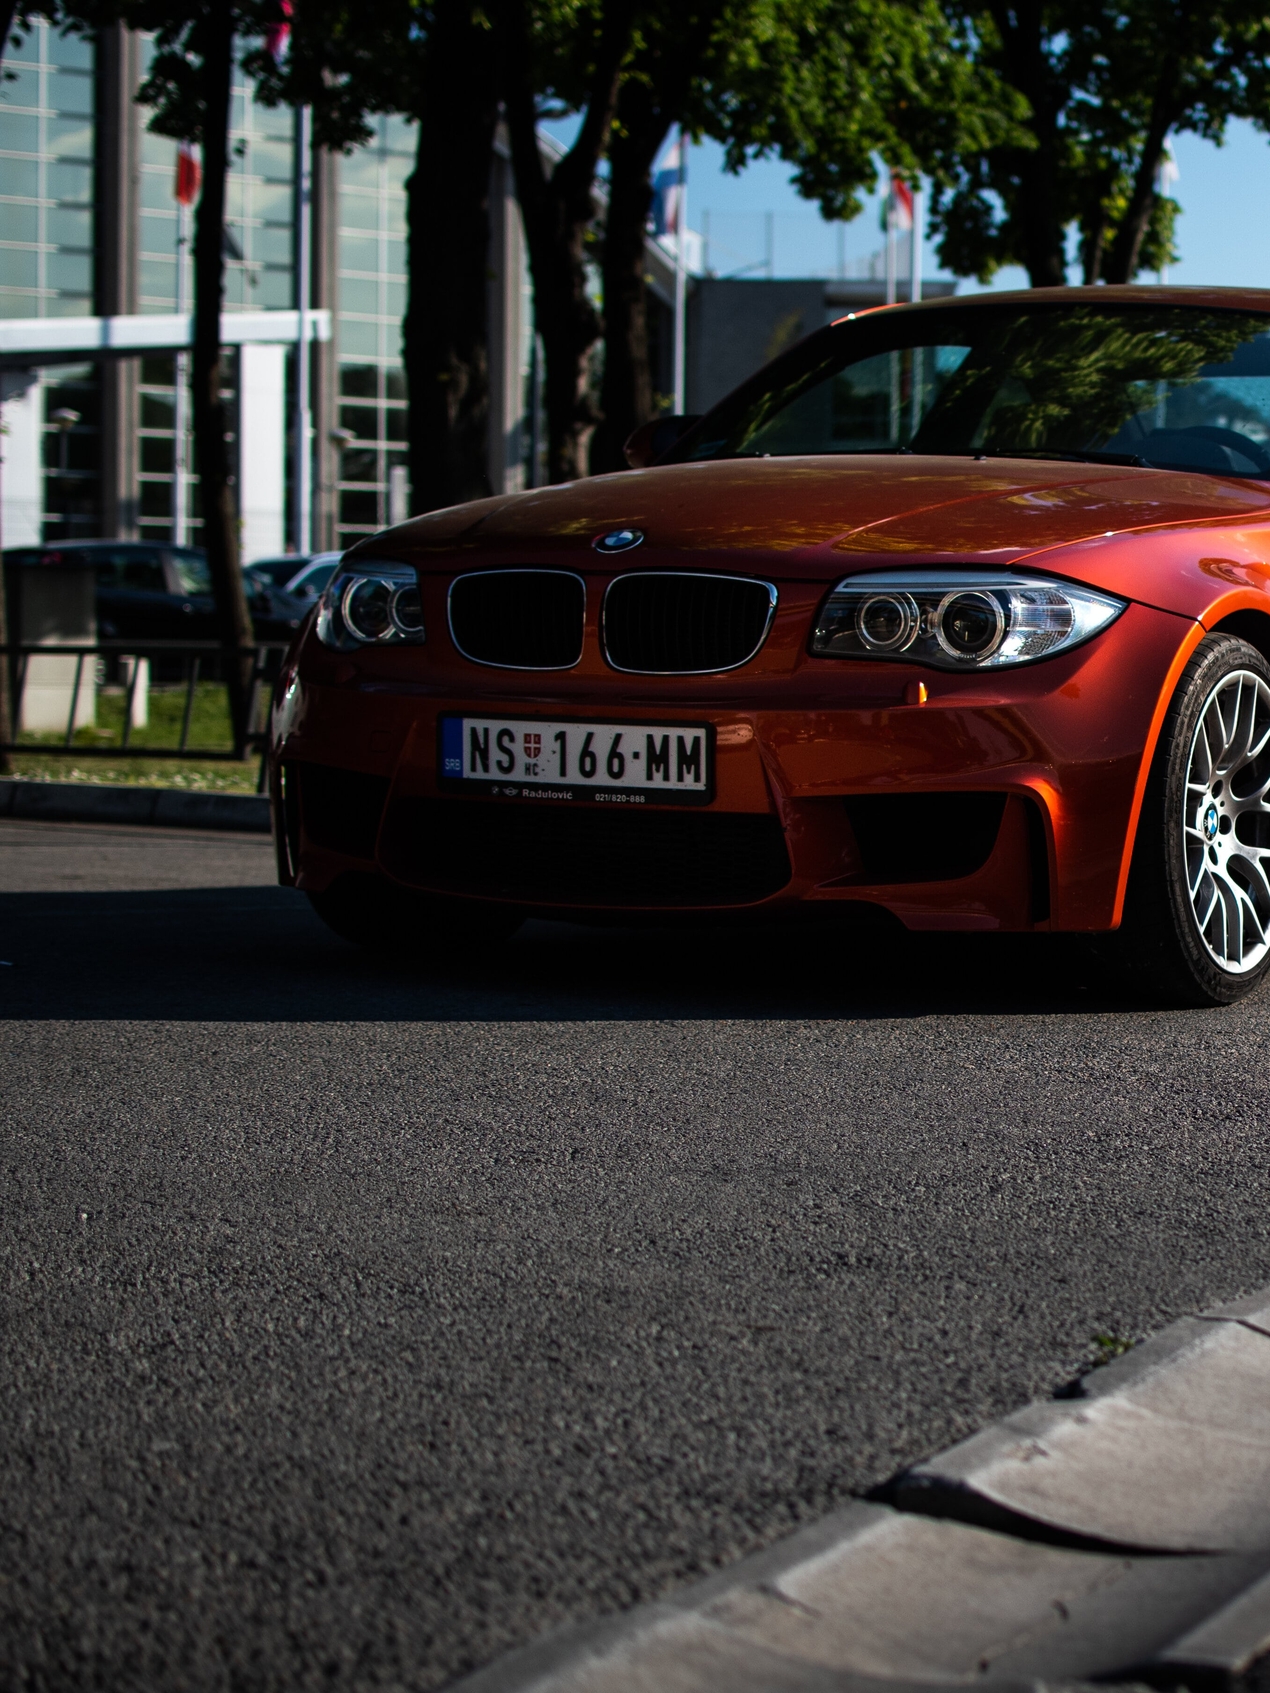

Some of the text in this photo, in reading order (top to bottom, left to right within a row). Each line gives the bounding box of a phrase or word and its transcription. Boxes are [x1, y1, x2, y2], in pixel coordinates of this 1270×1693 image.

[470, 726, 516, 774] NS
[444, 758, 461, 771] SRB
[522, 788, 573, 800] Radulović
